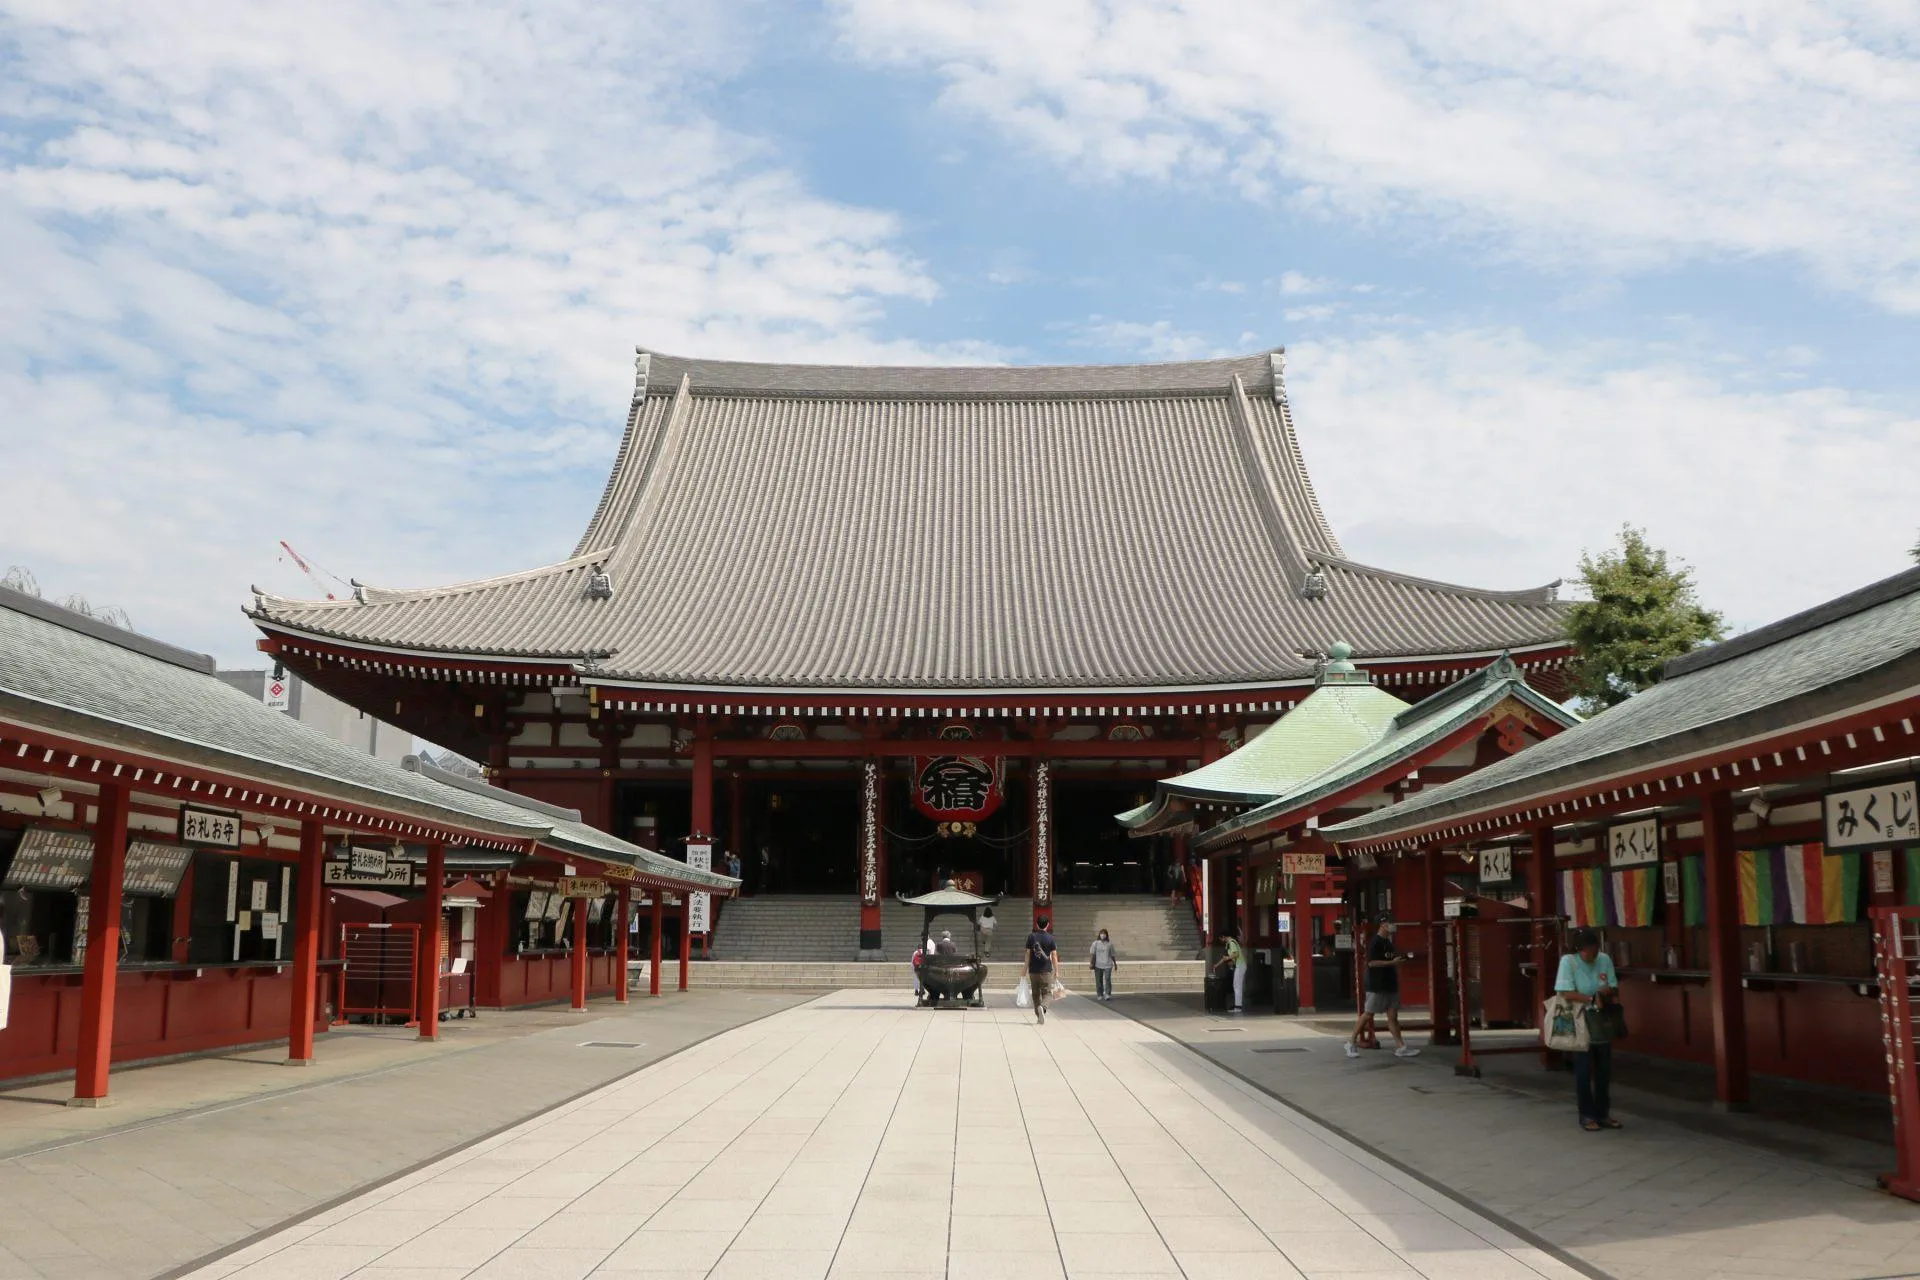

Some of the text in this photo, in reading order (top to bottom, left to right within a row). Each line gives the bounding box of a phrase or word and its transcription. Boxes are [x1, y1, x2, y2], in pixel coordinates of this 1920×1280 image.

[1838, 790, 1912, 837] みくじ
[187, 815, 234, 843] お札お守
[1615, 826, 1655, 858] みくじ
[1484, 852, 1510, 876] みくじ
